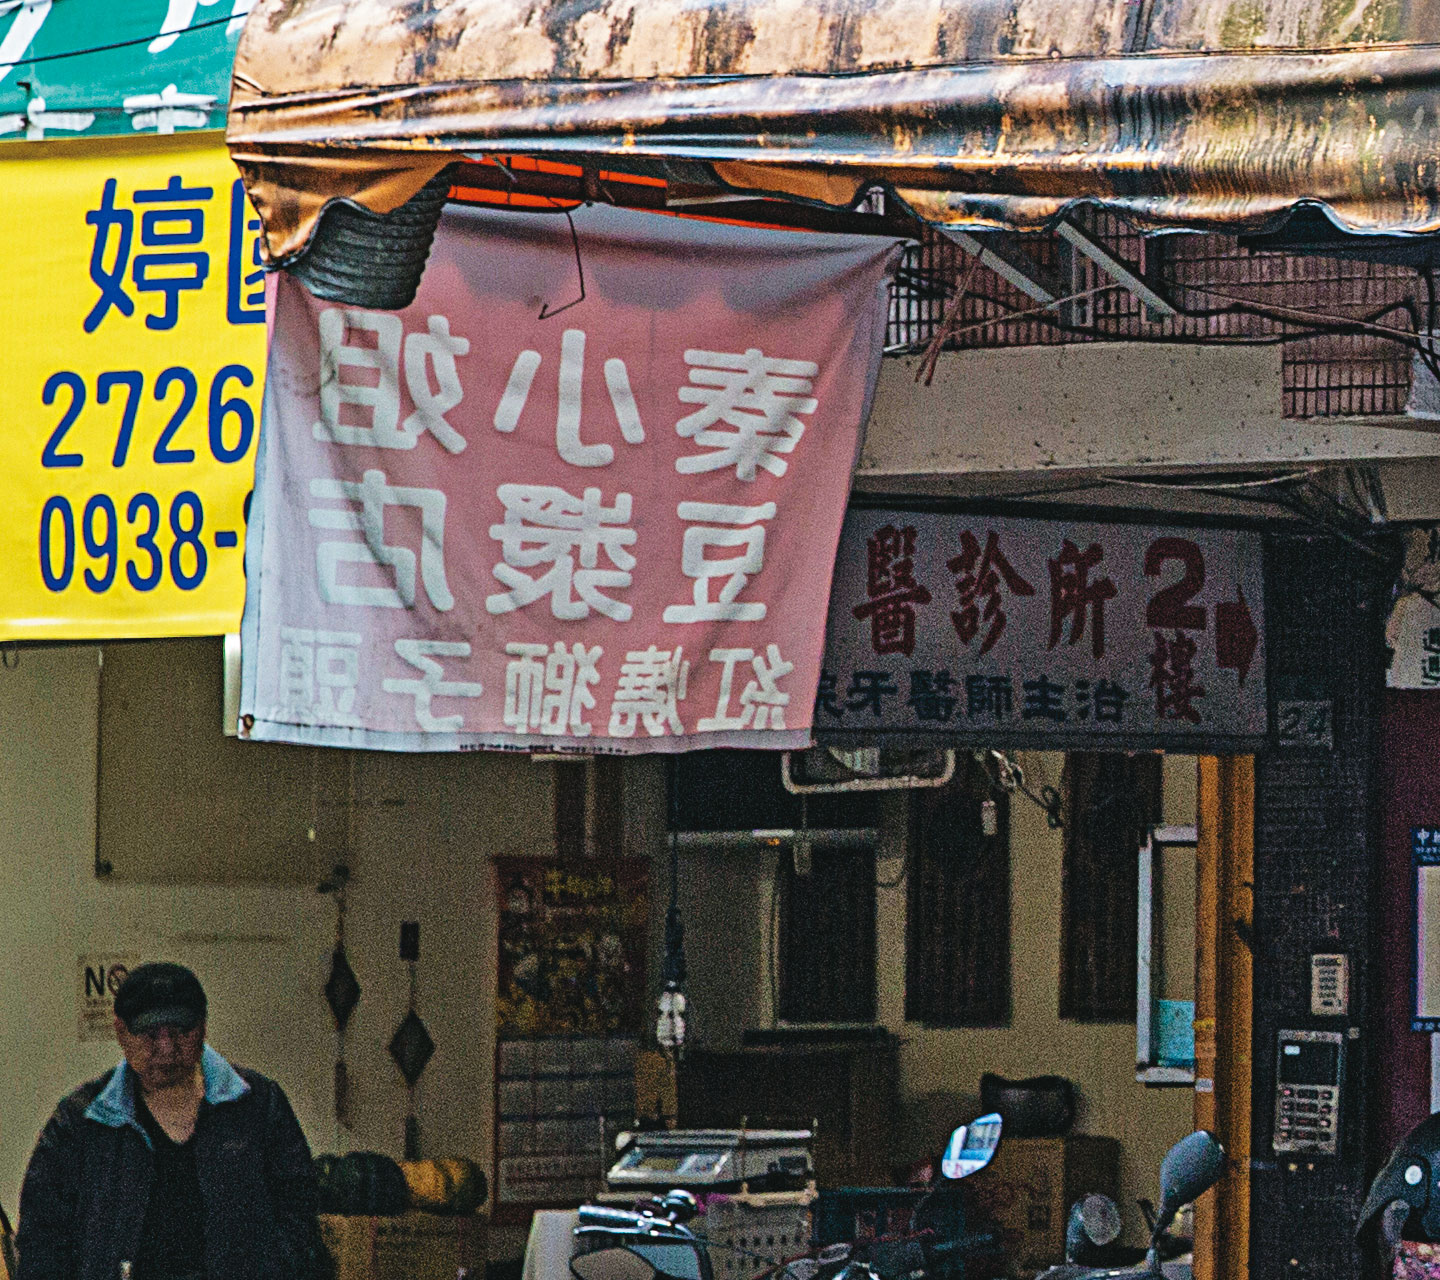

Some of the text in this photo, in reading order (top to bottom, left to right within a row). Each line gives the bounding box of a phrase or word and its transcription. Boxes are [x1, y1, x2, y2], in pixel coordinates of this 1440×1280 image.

[83, 175, 268, 333] 婷
[39, 490, 253, 595] 0938-
[851, 524, 1119, 659] 醫診所
